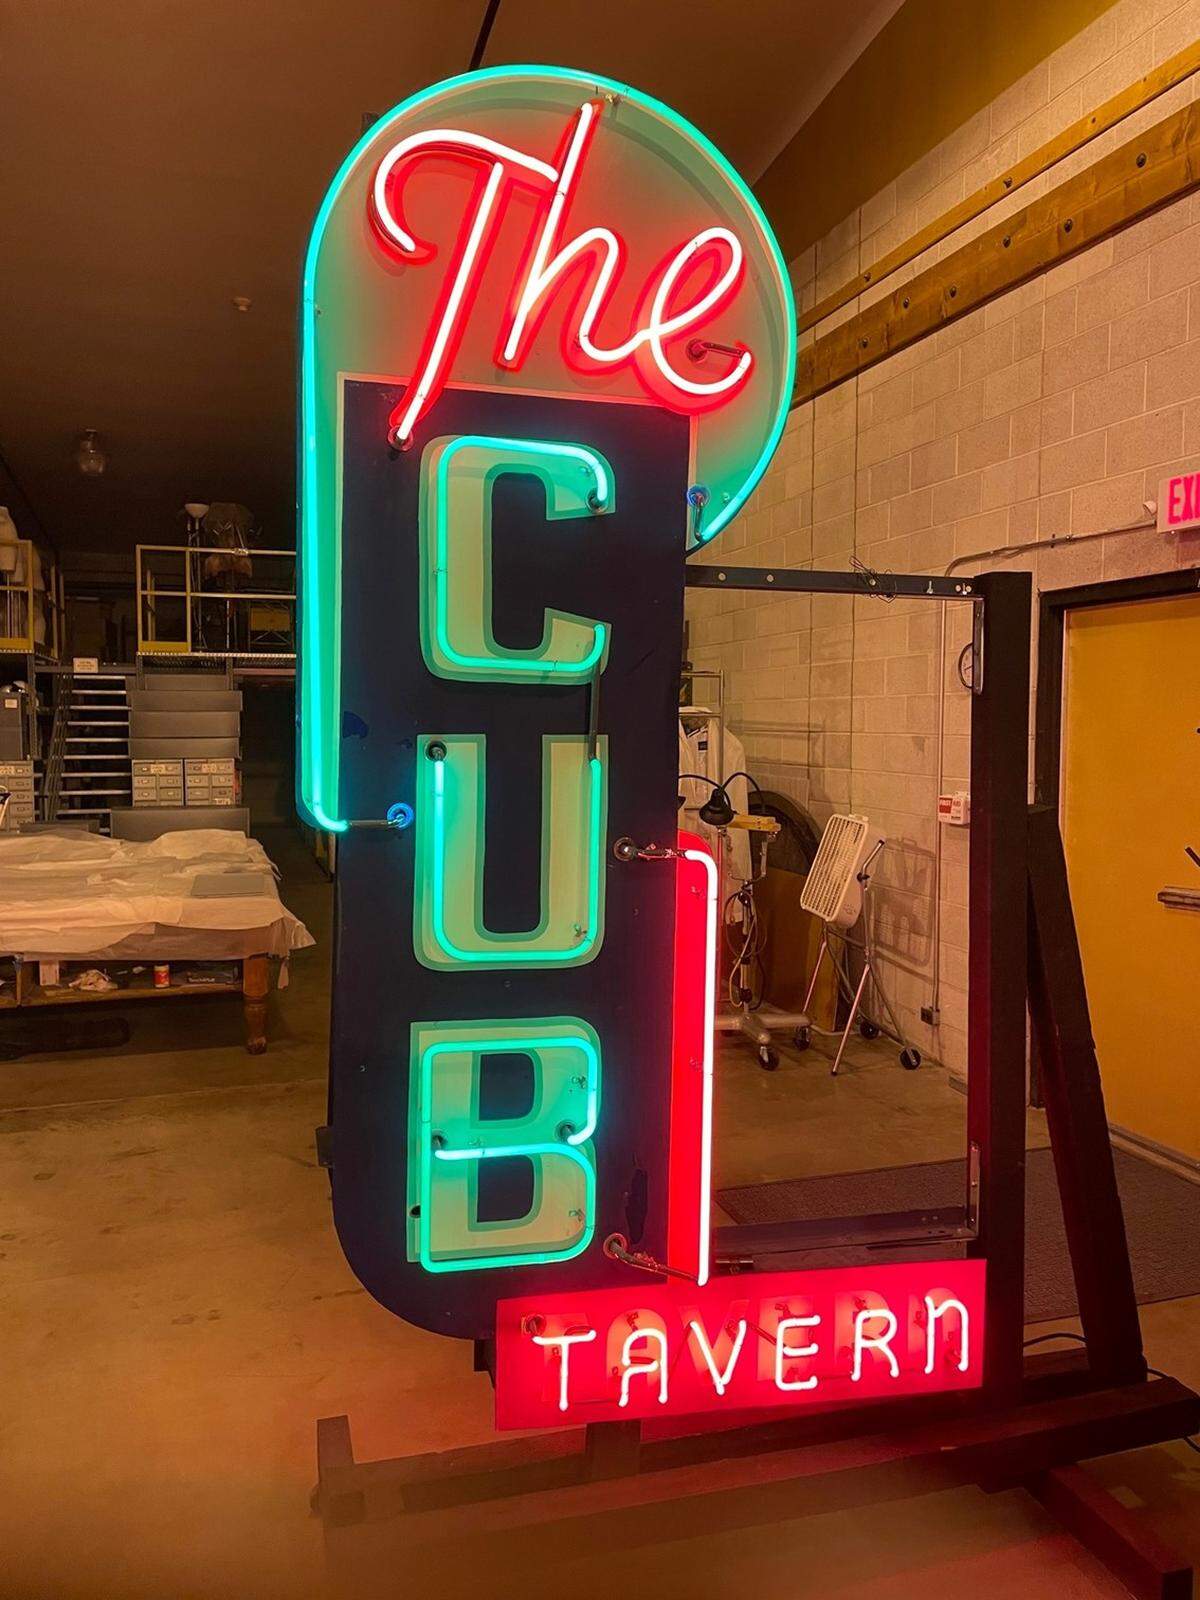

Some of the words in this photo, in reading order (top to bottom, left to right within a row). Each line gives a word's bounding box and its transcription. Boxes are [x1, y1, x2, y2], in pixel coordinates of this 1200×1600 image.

[368, 99, 756, 445] The
[407, 434, 617, 1275] CUB
[531, 1292, 971, 1412] TAVERN
